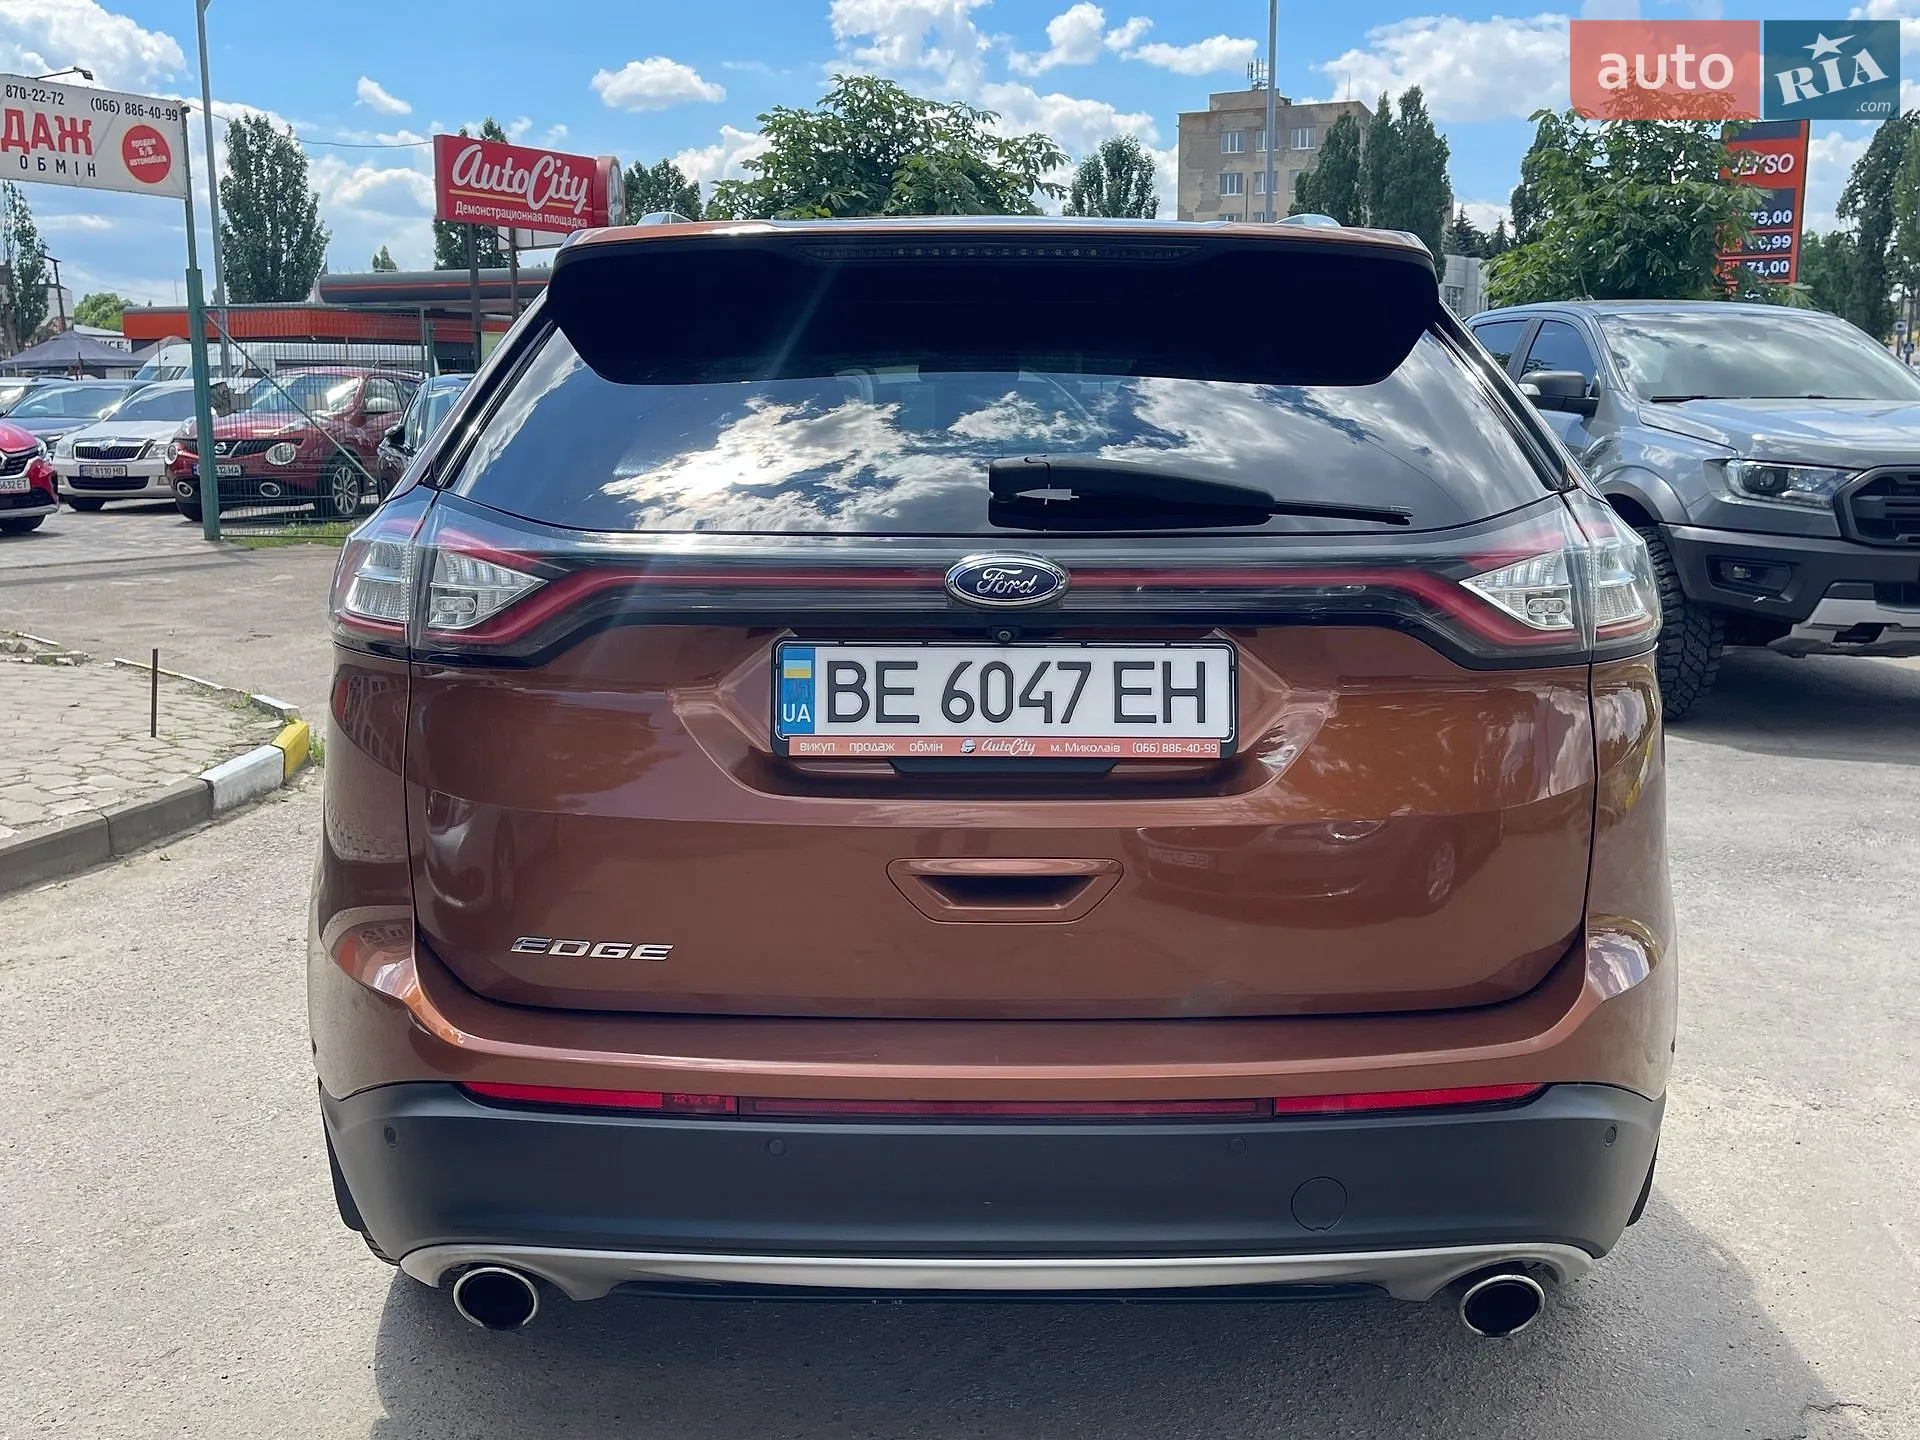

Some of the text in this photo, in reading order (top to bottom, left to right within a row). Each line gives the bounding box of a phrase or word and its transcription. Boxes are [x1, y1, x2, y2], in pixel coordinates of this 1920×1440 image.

[5, 84, 65, 106] 870-22-72
[90, 97, 178, 122] (066) 886-40-99
[19, 155, 97, 178] ОБМІН
[455, 200, 588, 229] Демонстрационная площадка
[976, 568, 1039, 595] Ford
[826, 660, 1206, 725] BE 6047 EH
[783, 703, 812, 724] UA
[799, 740, 944, 753] викуп продаж обмін
[1050, 741, 1121, 753] м. Миколаїв
[1131, 741, 1218, 754] (066) 886-40-99
[511, 936, 674, 961] EDGE
